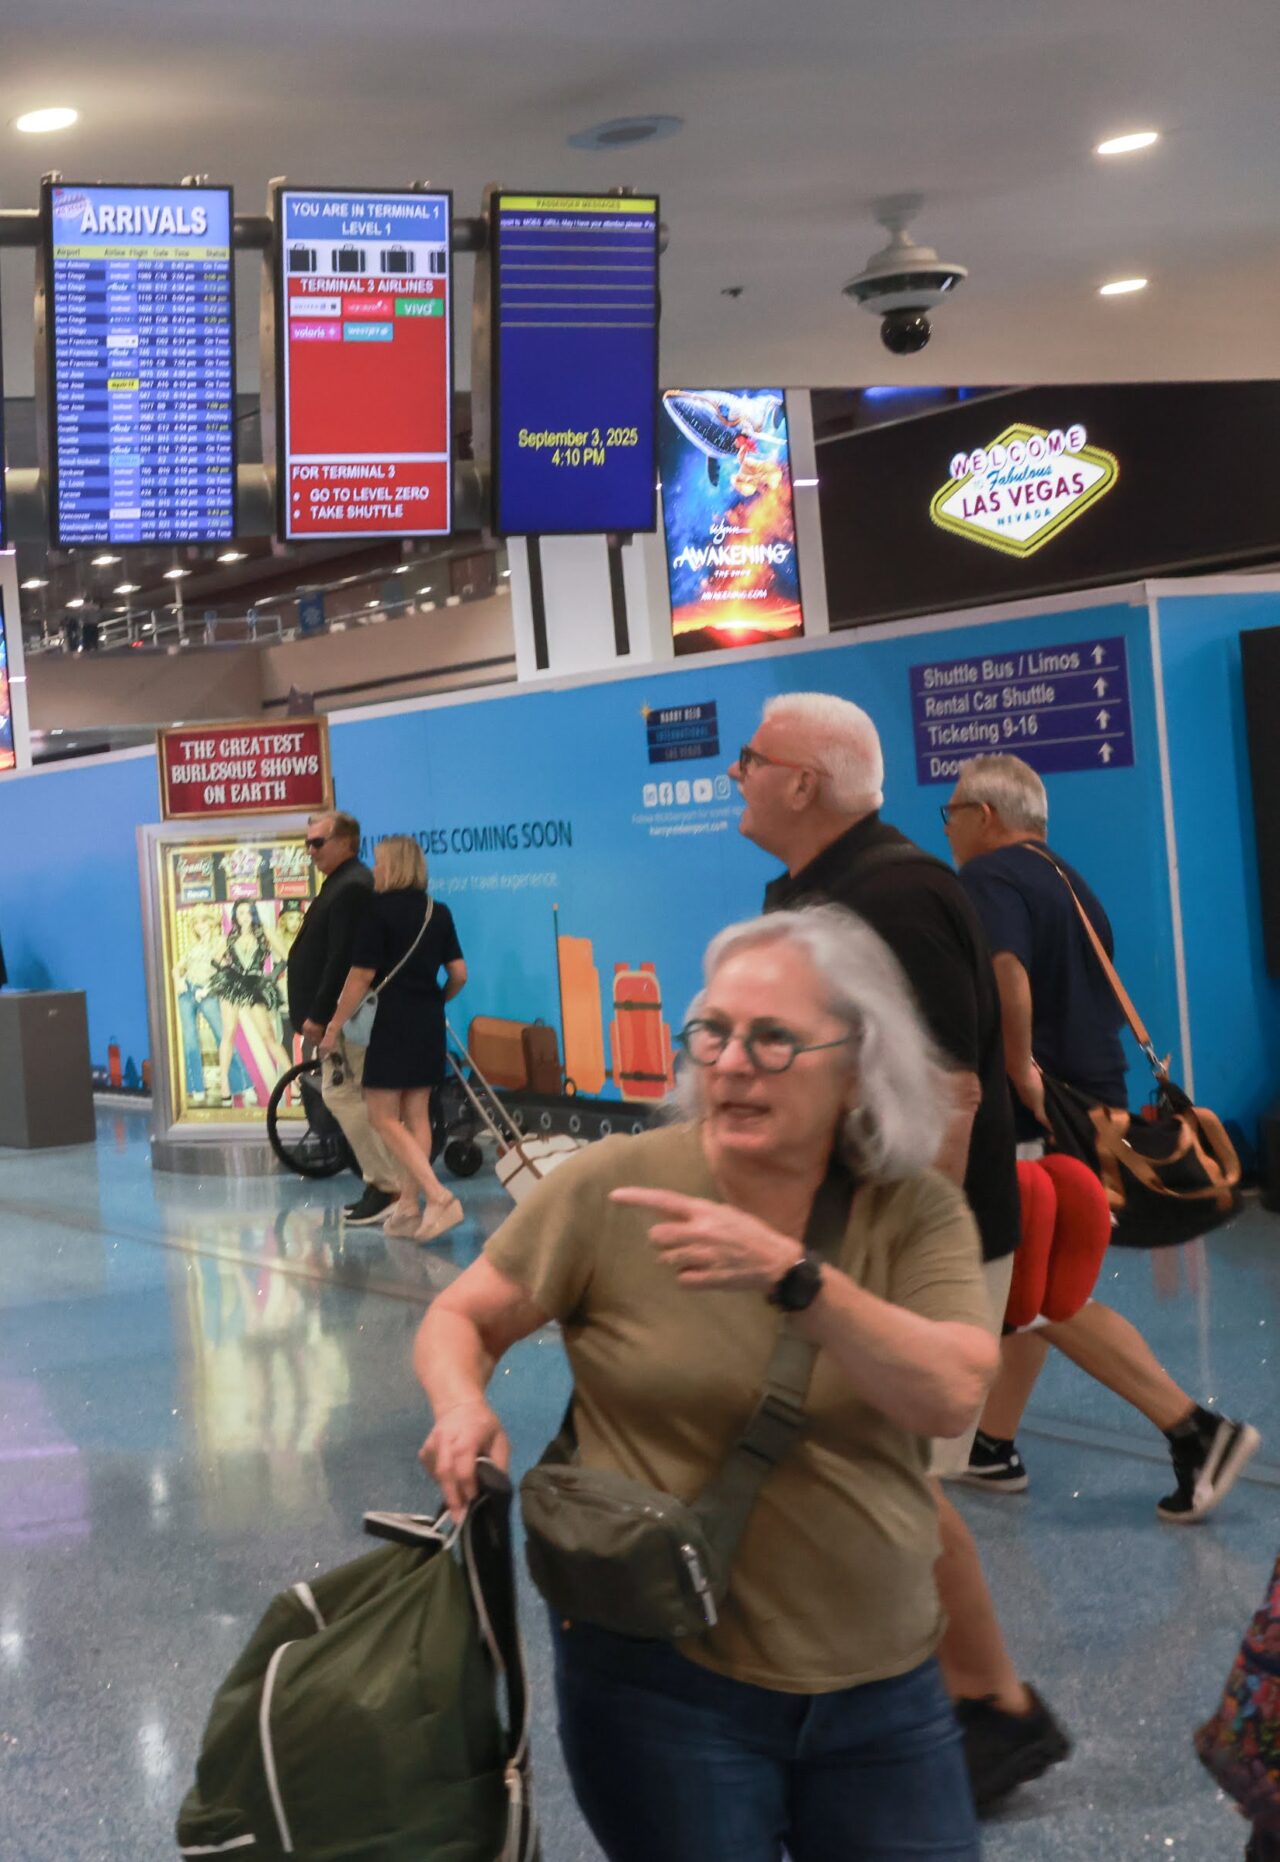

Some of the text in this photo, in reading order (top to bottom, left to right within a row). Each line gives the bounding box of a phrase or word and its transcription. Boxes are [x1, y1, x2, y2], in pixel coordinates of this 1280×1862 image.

[80, 206, 208, 234] ARRIVALS
[293, 203, 439, 218] YOU ARE IN TERMINAL 1
[342, 222, 391, 235] LEVEL 1
[130, 249, 148, 257] Flight
[301, 280, 433, 293] TERMINAL 3 AIRLINES
[295, 327, 325, 338] volaris
[518, 429, 639, 451] September 3, 2025
[551, 449, 606, 466] 4:10 PM
[952, 427, 1083, 479] WELCOME
[292, 466, 395, 480] FOR TERMINAL 3
[986, 463, 1053, 491] Fabulous
[310, 487, 429, 501] GO TO LEVEL ZERO
[962, 472, 1084, 519] LAS VEGAS
[311, 505, 404, 518] TAKE SHUTTLE
[997, 508, 1051, 526] NEVADA
[673, 543, 791, 571] AWAKENING
[924, 663, 978, 687] Shuttle
[982, 660, 1013, 680] Bus
[1028, 652, 1080, 674] Limos
[926, 684, 1055, 717] Rental Car Shuttle
[928, 715, 1038, 746] Ticketing 9-16
[180, 733, 304, 760] THE GREATEST
[172, 755, 319, 784] BURLESQUE SHOWS
[203, 781, 286, 805] ON EARTH
[451, 824, 518, 854] COMING
[522, 820, 573, 848] SOON
